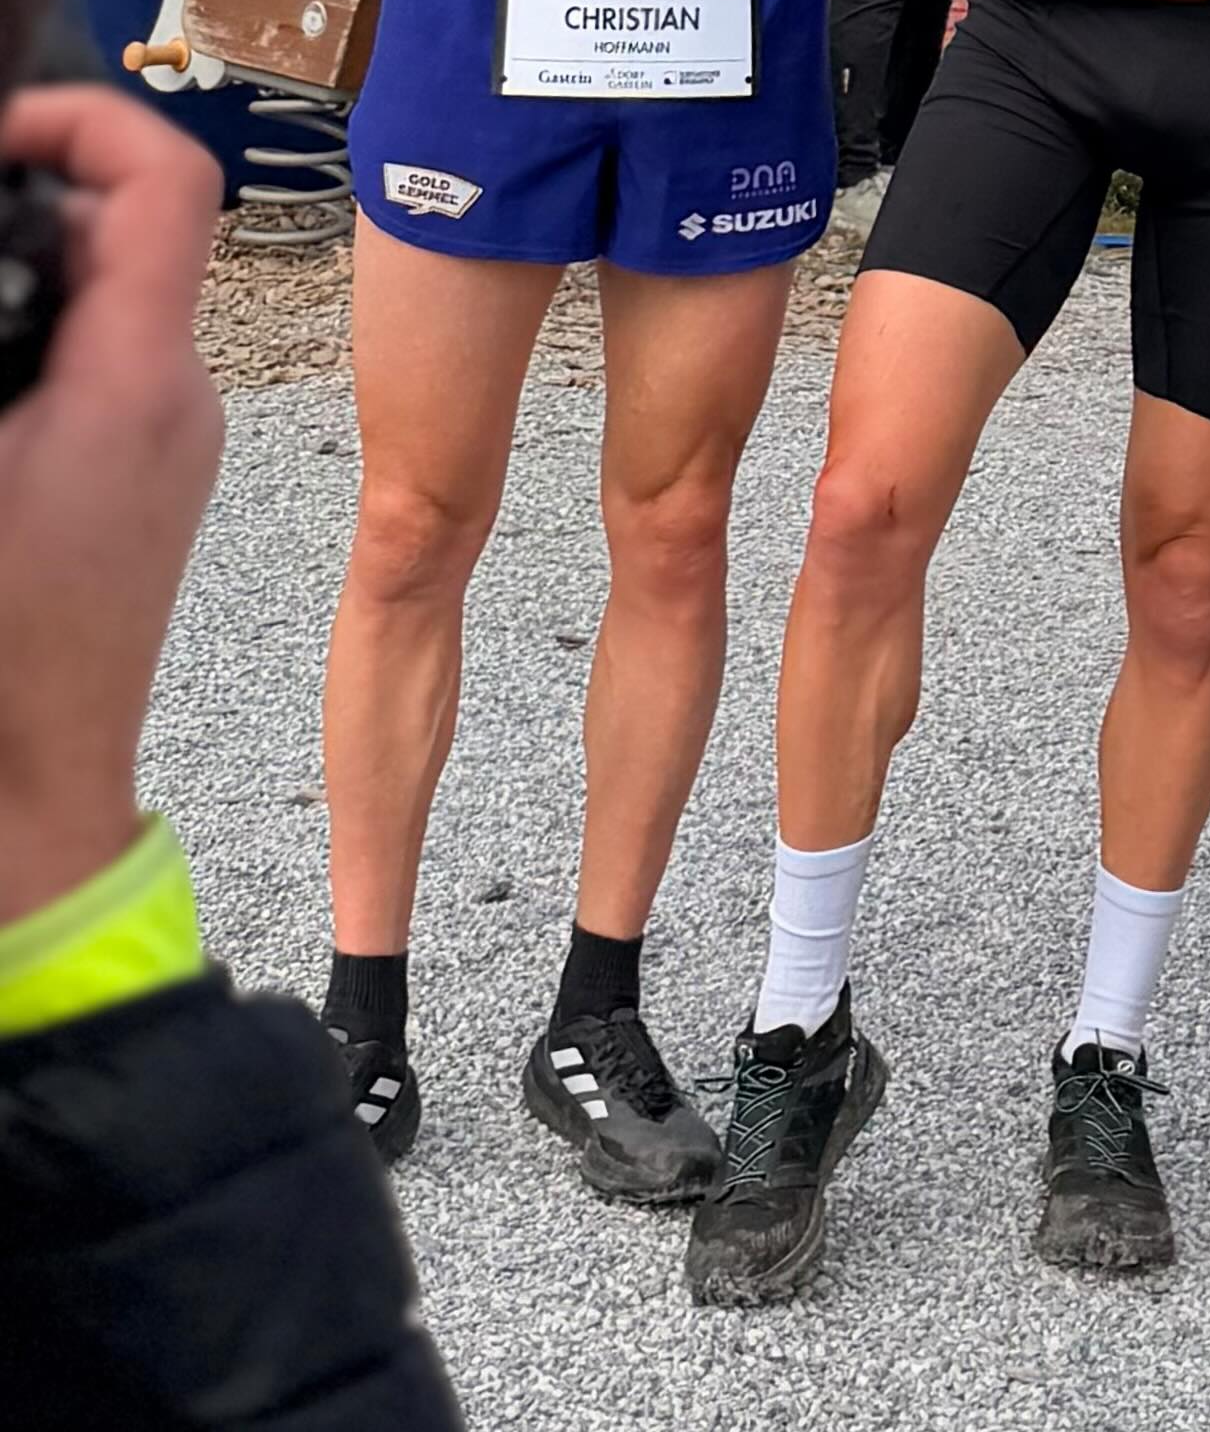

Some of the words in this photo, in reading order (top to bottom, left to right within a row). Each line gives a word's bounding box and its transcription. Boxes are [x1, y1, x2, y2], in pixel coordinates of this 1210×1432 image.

[564, 6, 701, 32] CHRISTIAN
[594, 41, 671, 54] HOFFMANN
[537, 69, 593, 85] Gastein
[408, 173, 451, 191] GOLD
[398, 183, 460, 207] SEMMEL
[711, 197, 817, 235] SUZUKI
